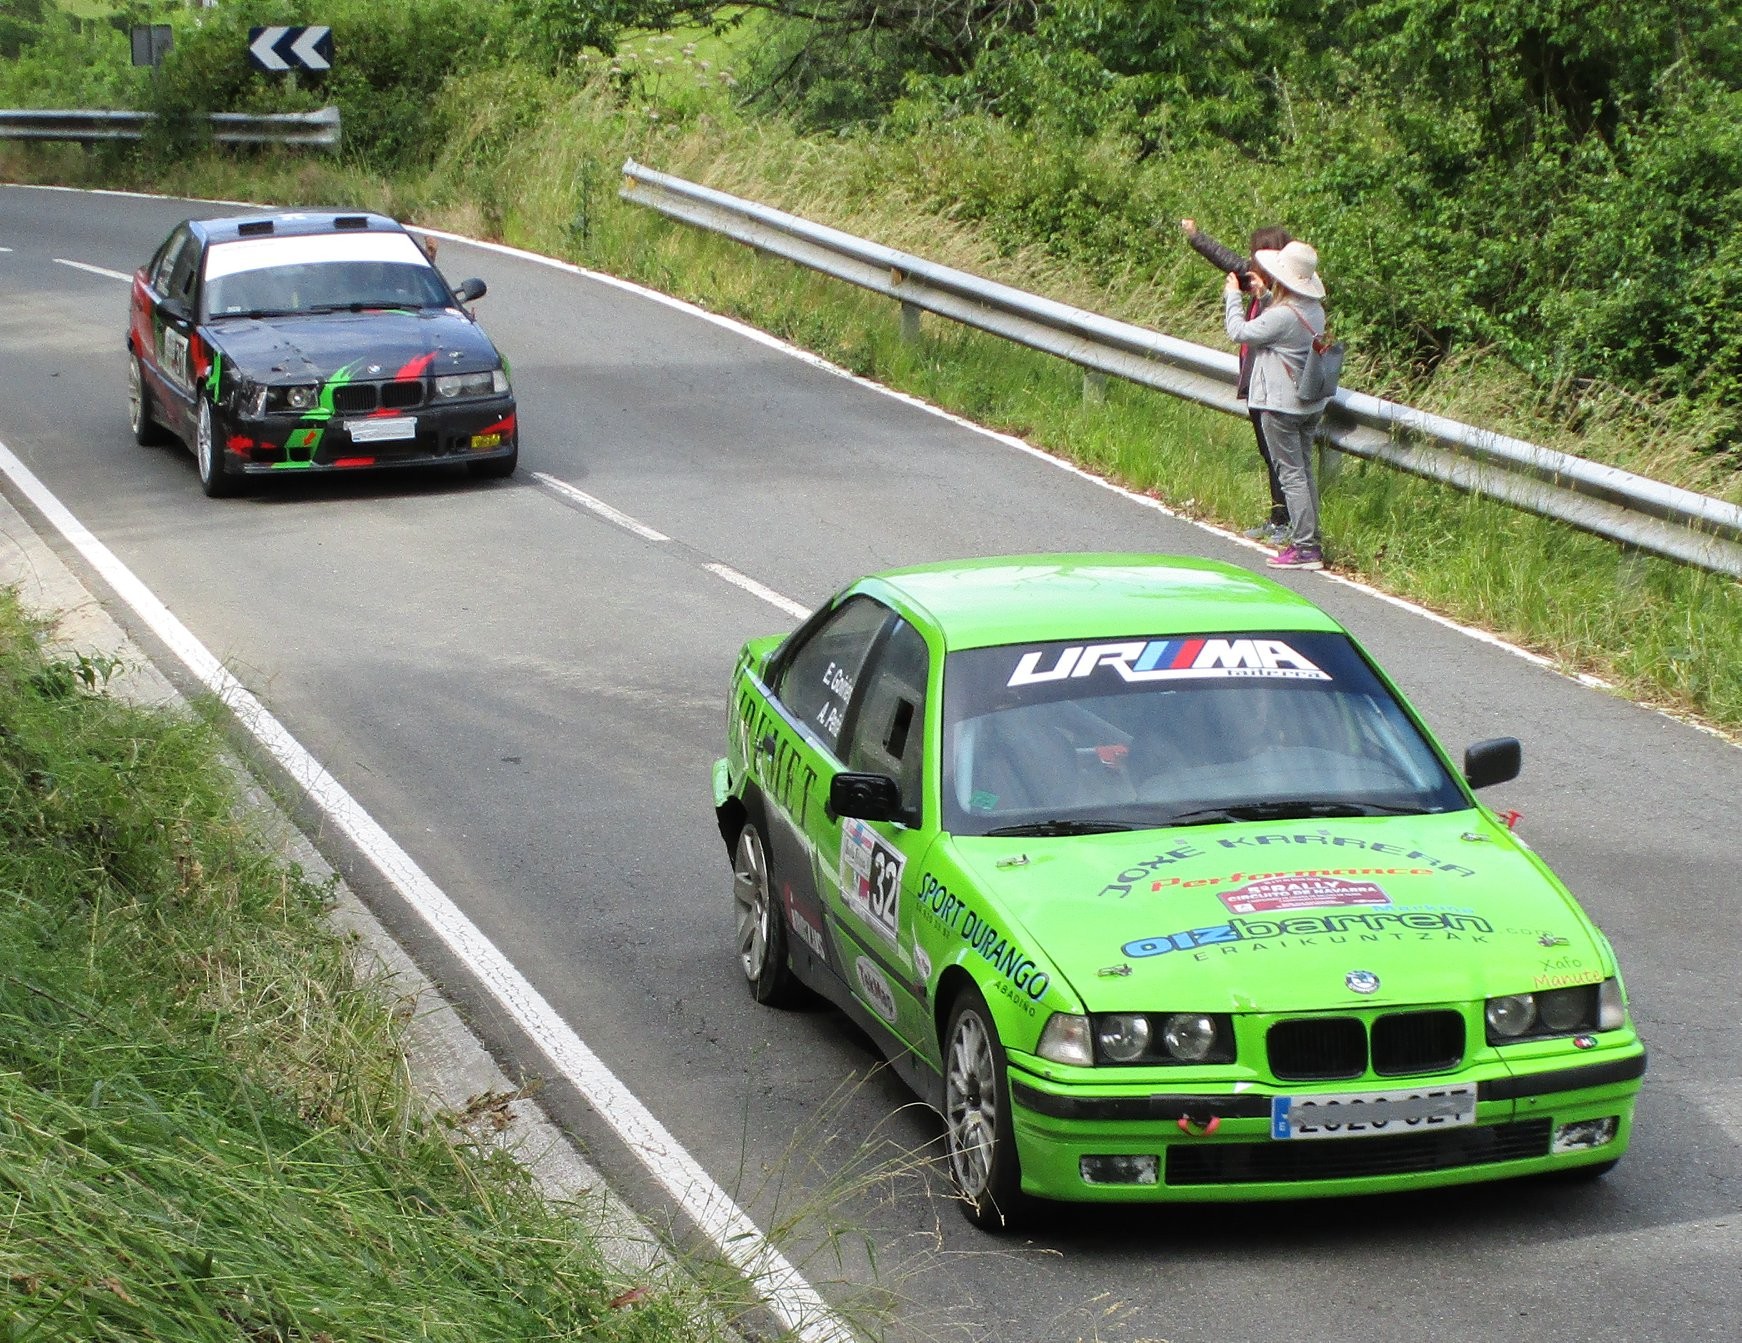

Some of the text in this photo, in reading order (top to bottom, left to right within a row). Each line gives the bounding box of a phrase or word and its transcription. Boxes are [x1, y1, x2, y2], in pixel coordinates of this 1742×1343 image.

[873, 852, 896, 928] 32
[1098, 834, 1476, 898] JOXE KARRERA
[1227, 891, 1291, 902] CIRCUITO
[1292, 888, 1311, 897] DE
[1313, 886, 1378, 896] NAVARRA
[1270, 881, 1339, 893] RALLY
[918, 872, 966, 928] SPORT
[961, 911, 1050, 1001] DURANGO
